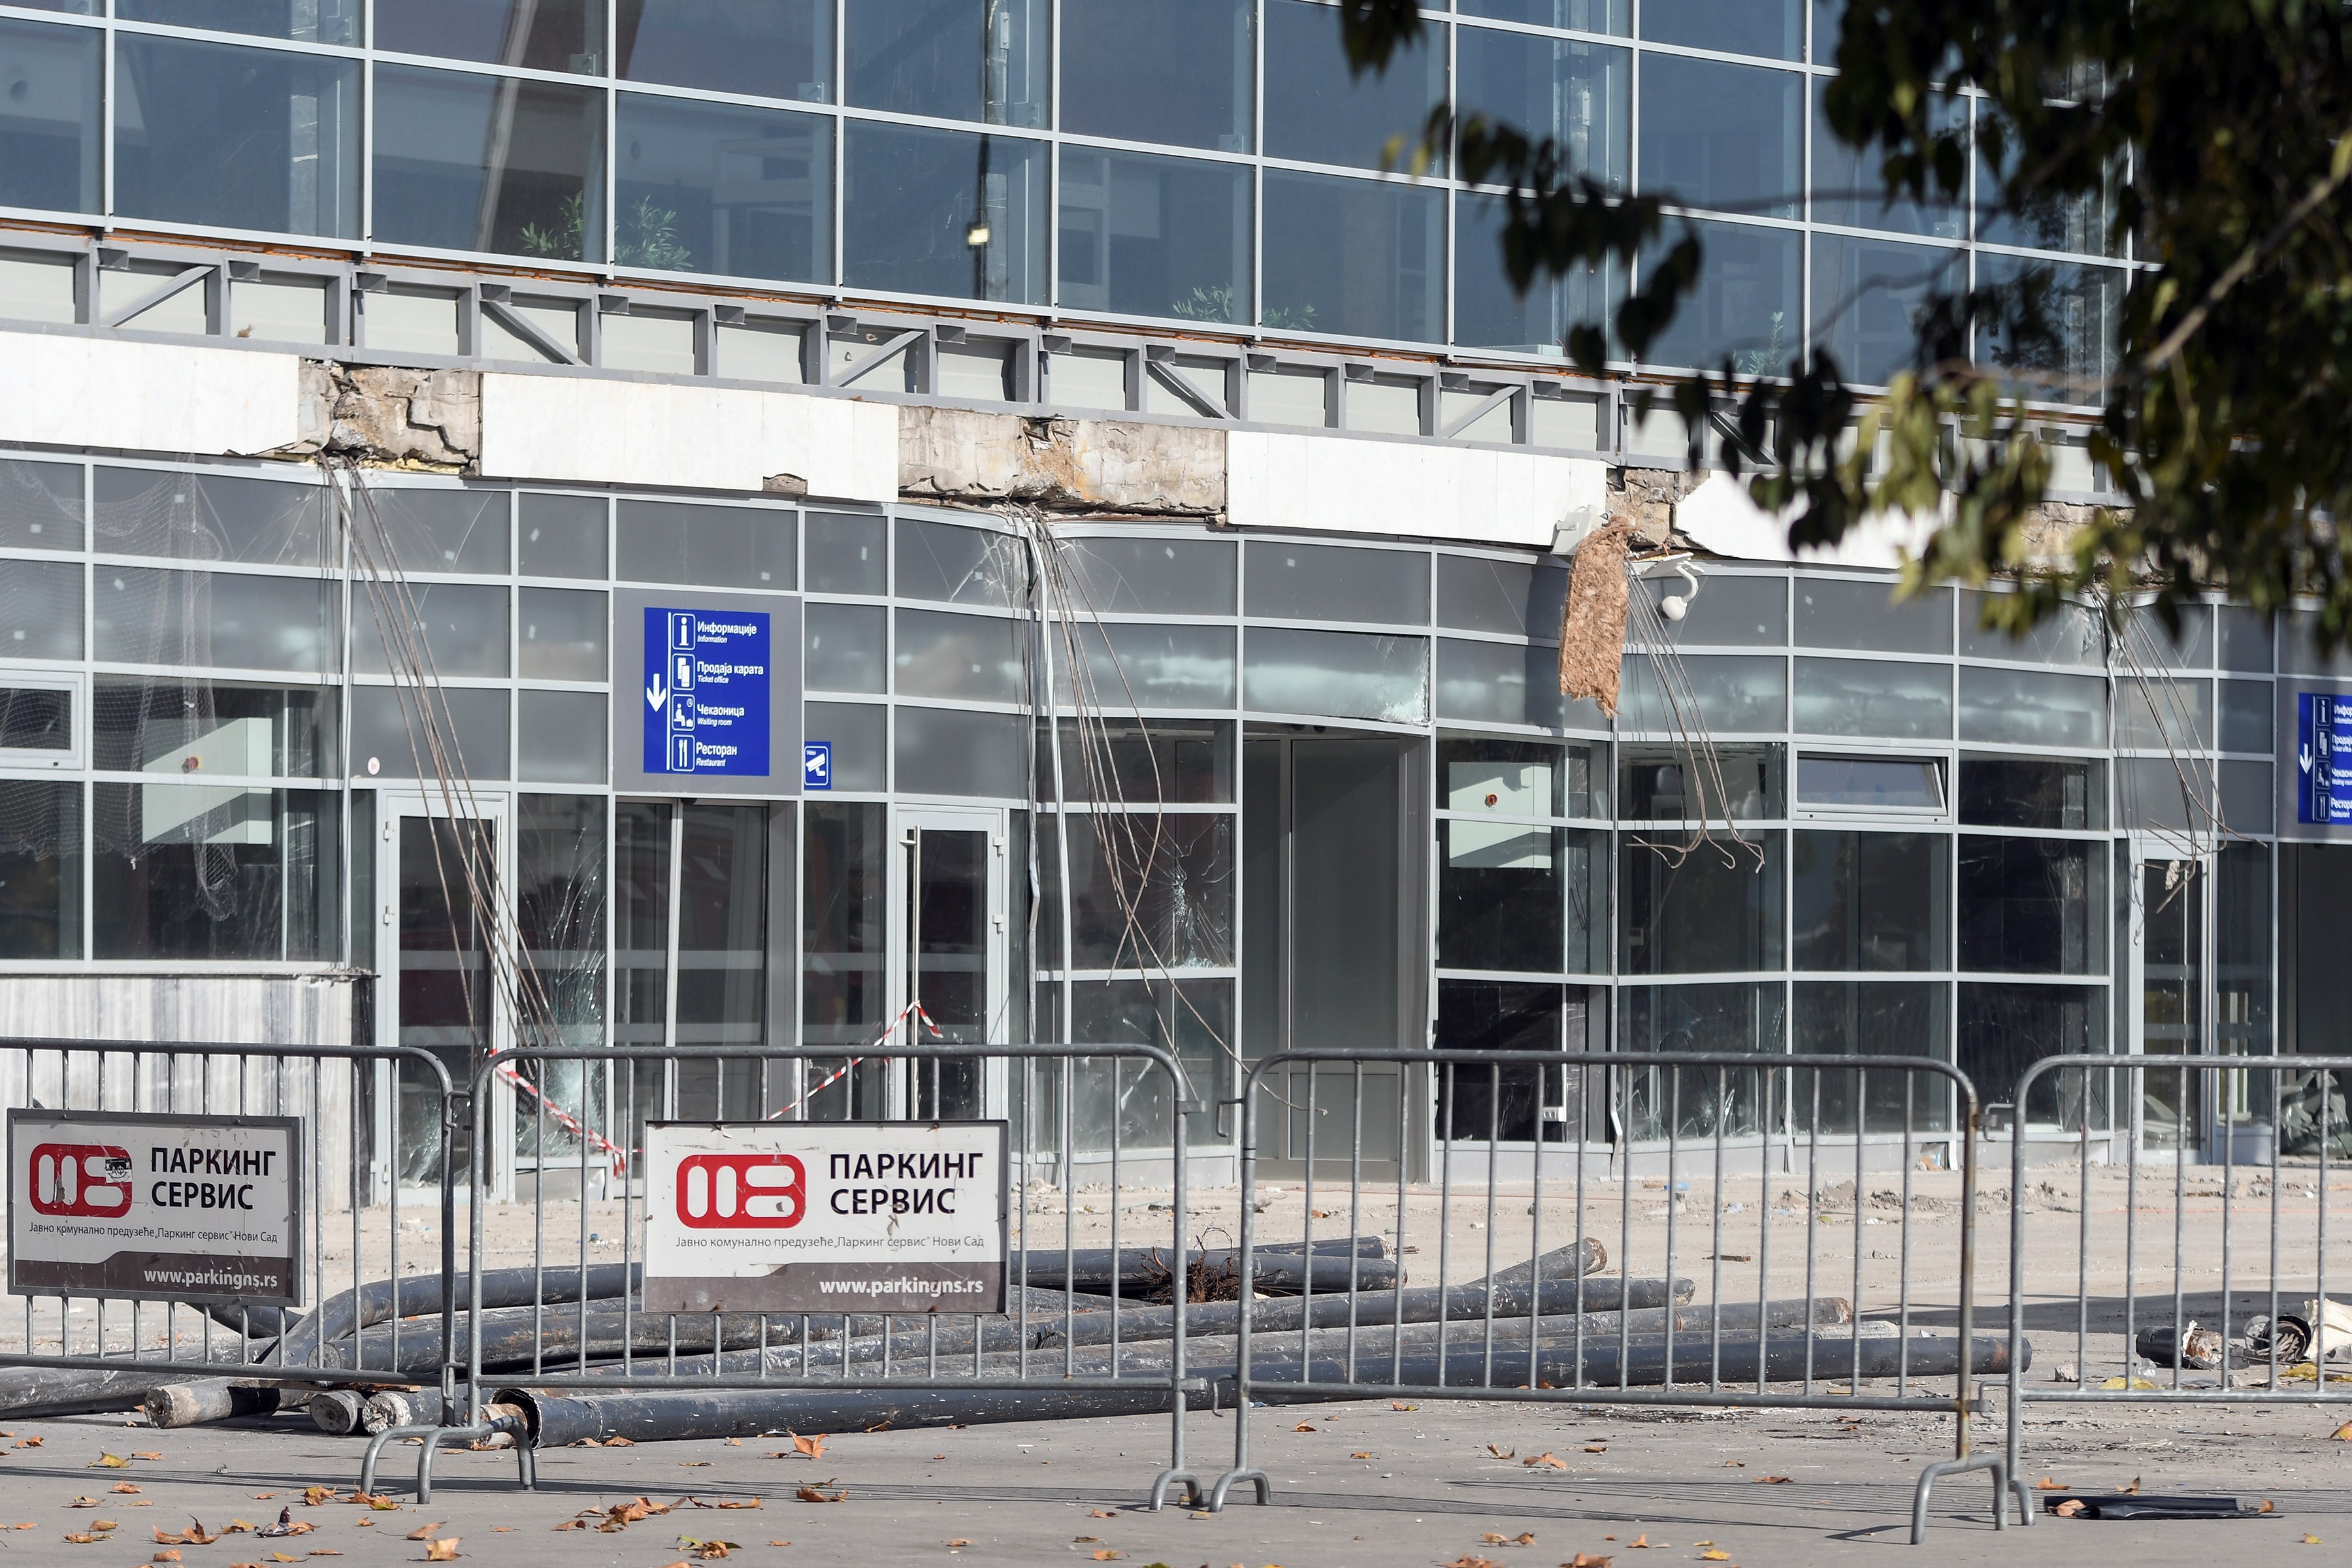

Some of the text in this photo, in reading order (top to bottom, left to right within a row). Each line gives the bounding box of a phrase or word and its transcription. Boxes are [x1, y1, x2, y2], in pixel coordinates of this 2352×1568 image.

[697, 621, 757, 636] Информације
[697, 661, 764, 676] Продаја карата
[697, 704, 745, 717] Чекаоница
[697, 717, 717, 727] Waiting
[696, 742, 737, 758] Ресторан
[696, 757, 726, 766] Restaurant
[151, 1147, 276, 1177] ПАРКИНГ
[830, 1153, 983, 1179] ПАРКИНГ
[152, 1181, 253, 1209] СЕРВИС
[830, 1188, 956, 1215] СЕРВИС
[29, 1222, 54, 1232] Јавно
[57, 1225, 105, 1235] комунално
[107, 1227, 154, 1238] предузеће
[235, 1231, 258, 1241] Нови
[261, 1232, 278, 1243] Сад
[676, 1237, 707, 1247] Јавно
[710, 1239, 771, 1249] комунално
[774, 1236, 833, 1249] предузеће
[933, 1236, 960, 1247] Нови
[964, 1236, 984, 1248] Сад
[144, 1267, 278, 1289] www.parkingns.rs
[820, 1276, 983, 1297] www.parkingns.rs
